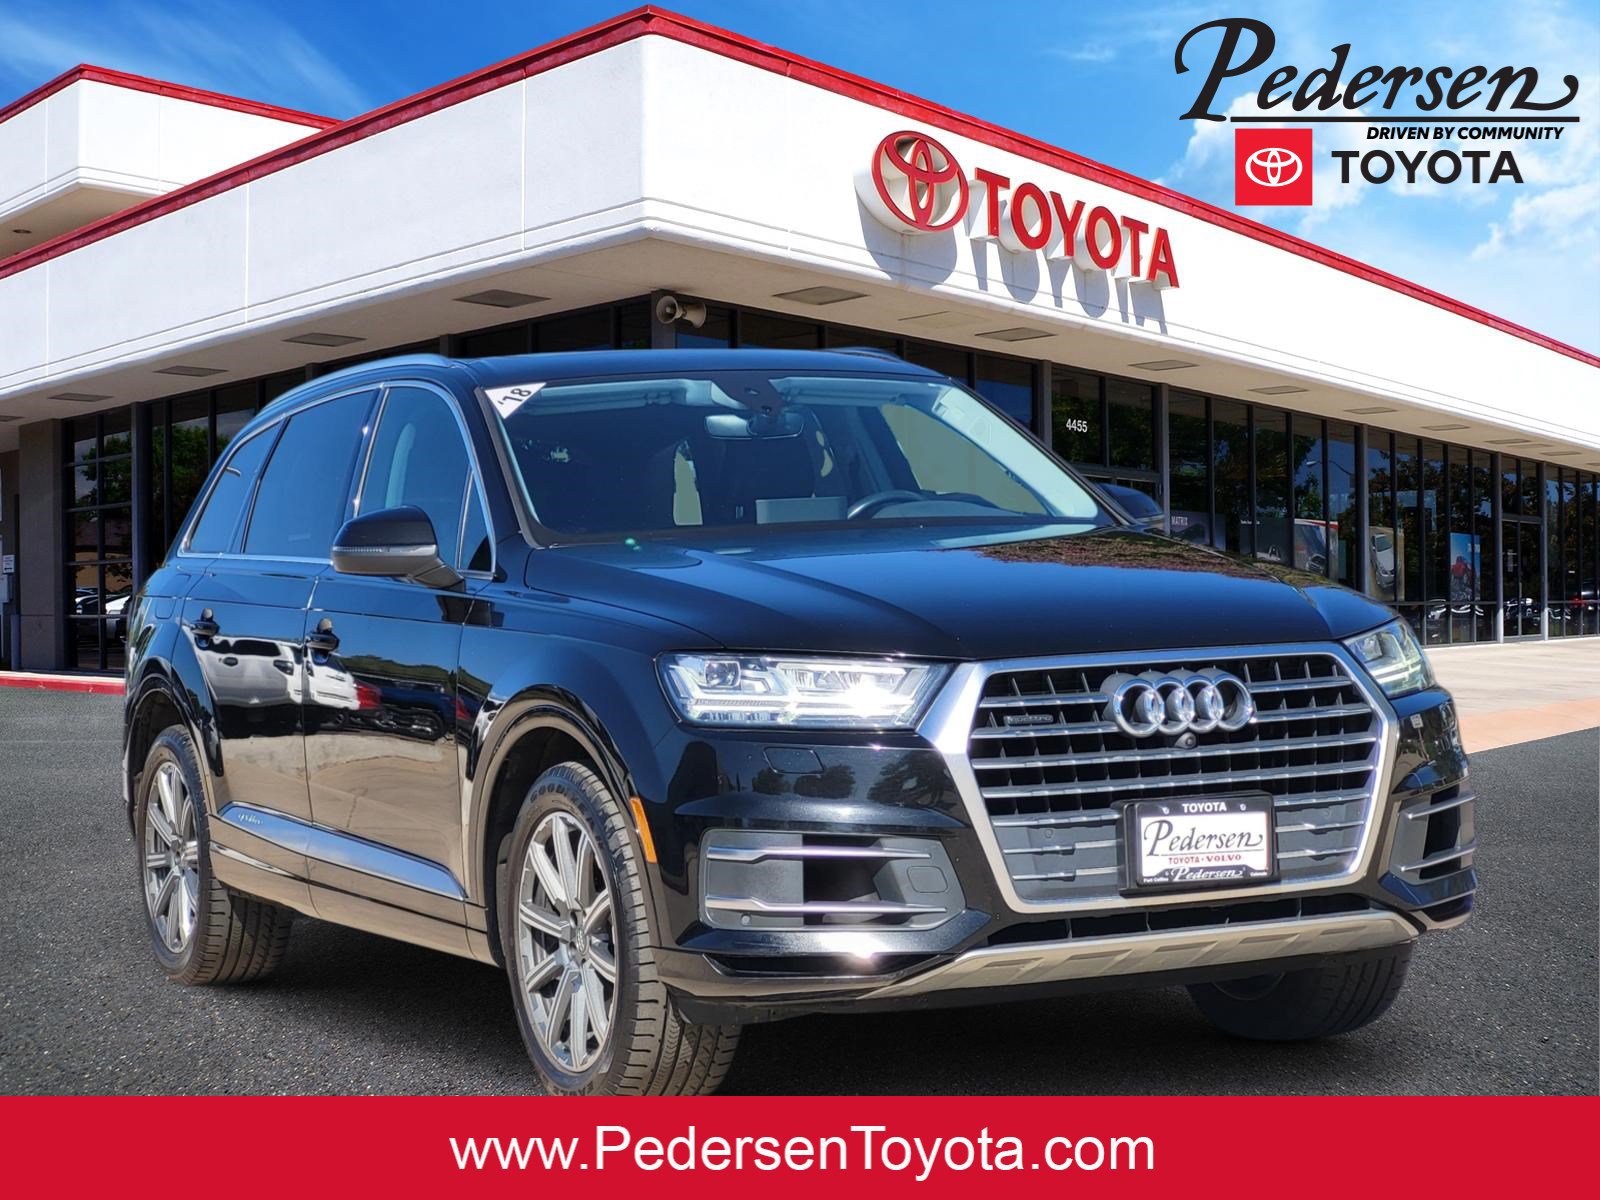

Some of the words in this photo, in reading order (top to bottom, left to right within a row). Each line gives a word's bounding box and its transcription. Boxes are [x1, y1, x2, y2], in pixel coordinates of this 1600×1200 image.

[974, 167, 1180, 288] TOYOTA
[1065, 418, 1088, 433] 4455
[1181, 802, 1228, 814] TOYOTA
[1143, 819, 1264, 857] Pedersen
[1168, 856, 1201, 866] TOYOTA
[1206, 854, 1242, 863] VOLVO
[1171, 866, 1244, 882] Pedersen
